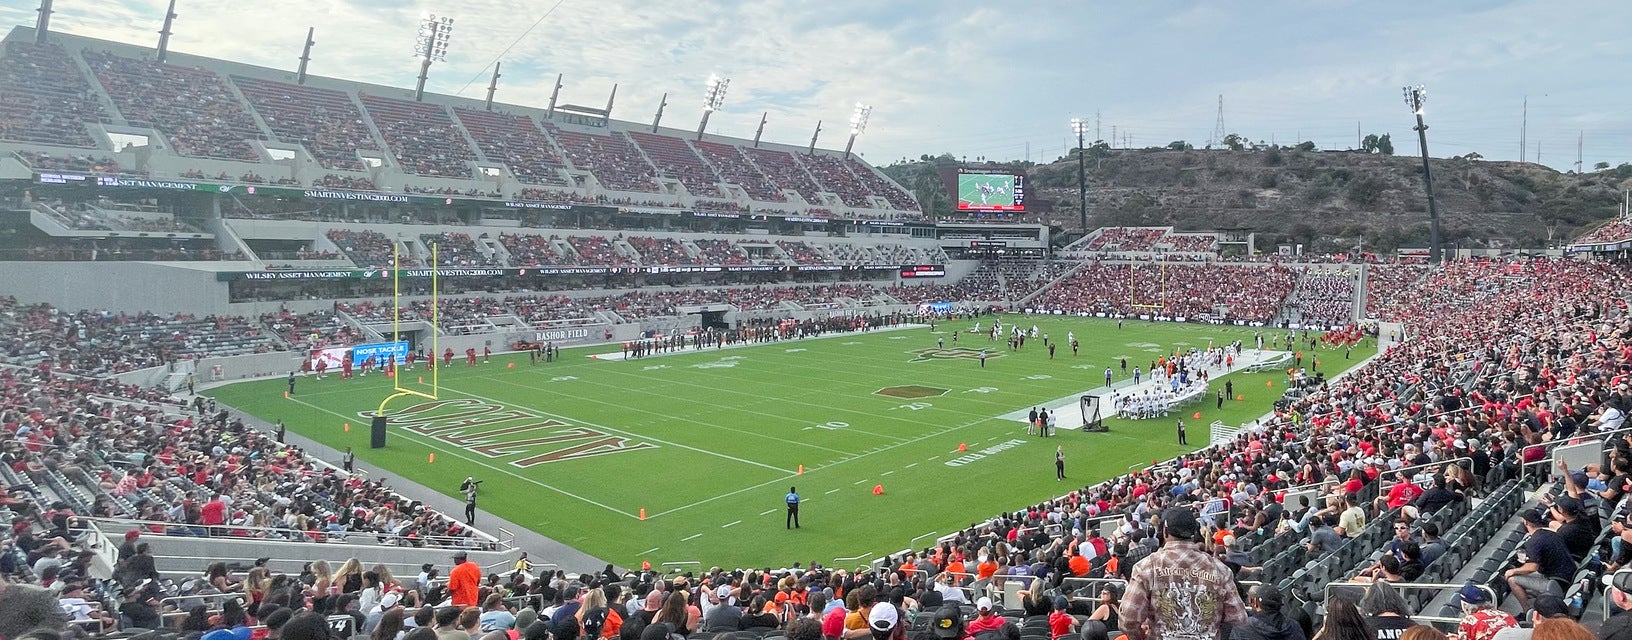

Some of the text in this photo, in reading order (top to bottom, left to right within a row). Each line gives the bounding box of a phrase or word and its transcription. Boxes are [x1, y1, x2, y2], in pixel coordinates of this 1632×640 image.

[138, 181, 197, 189] MANAGEMENT
[536, 329, 588, 341] BASHOR FIELD
[899, 402, 933, 410] 20
[815, 421, 849, 430] 10
